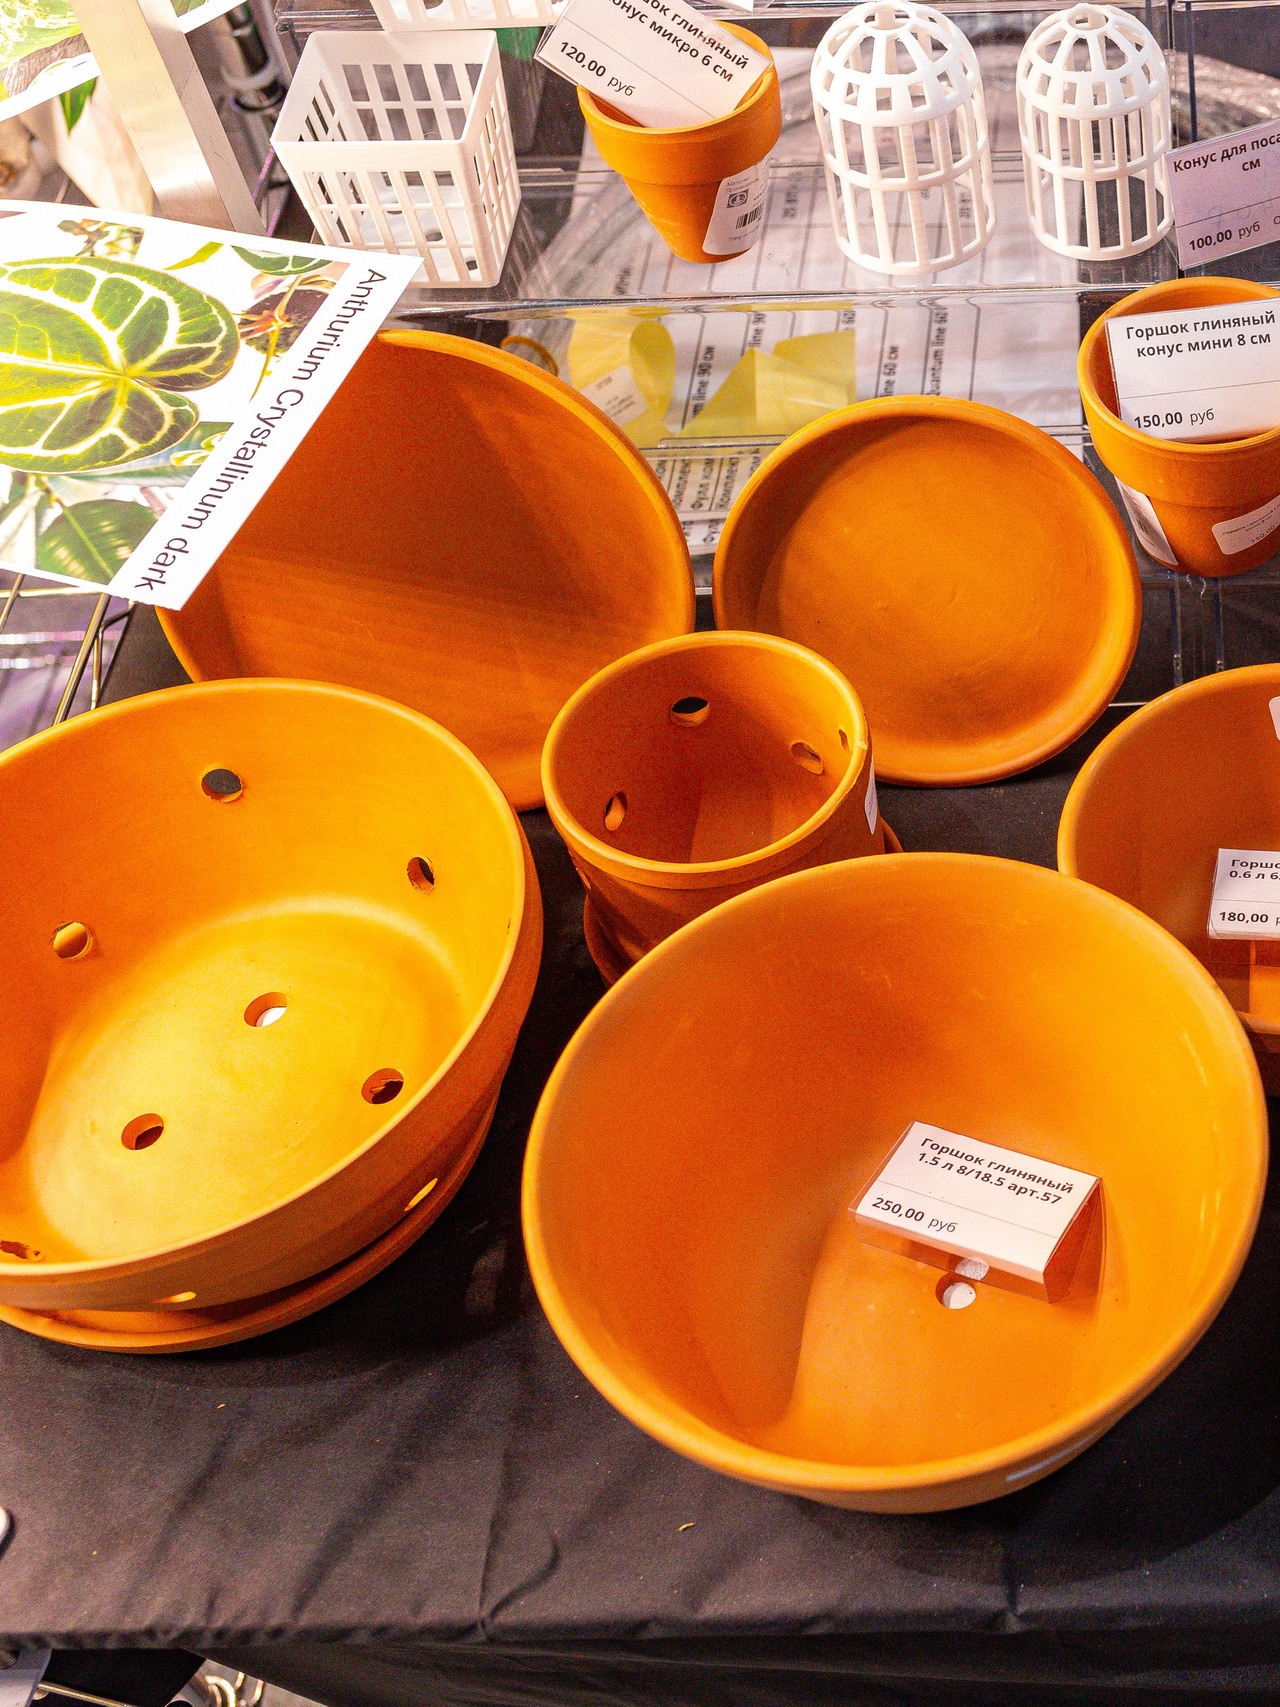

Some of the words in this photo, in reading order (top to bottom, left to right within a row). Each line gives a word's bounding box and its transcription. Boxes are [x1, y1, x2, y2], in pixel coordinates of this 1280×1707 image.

[609, 0, 648, 23] онус
[649, 21, 699, 58] микро
[701, 55, 713, 66] 6
[713, 64, 733, 82] см
[671, 13, 749, 69] глиняный
[560, 41, 606, 77] 120,00
[607, 75, 636, 96] руб
[1173, 152, 1217, 172] Конус
[1221, 143, 1247, 162] для
[1241, 159, 1261, 171] см
[1189, 229, 1232, 250] 100,00
[1238, 221, 1260, 239] руб
[292, 269, 387, 381] Anthurium
[1126, 322, 1189, 341] Горшок
[1193, 311, 1276, 333] глиняный
[1137, 341, 1184, 357] конус
[1188, 338, 1233, 352] мини
[1237, 333, 1246, 346] 8
[1250, 331, 1271, 344] см
[1134, 411, 1183, 428] 150,00
[1190, 408, 1215, 425] руб
[181, 388, 304, 530] Crystallinum
[134, 537, 189, 591] dark
[1229, 870, 1251, 879] 0.6
[1255, 872, 1265, 880] л
[1219, 911, 1269, 924] 180,00
[918, 1152, 940, 1166] 1.5
[941, 1161, 954, 1171] л
[956, 1164, 1004, 1187] 8/18.5
[1007, 1183, 1063, 1205] арт.57
[921, 1138, 984, 1166] Горшок
[987, 1160, 1074, 1194] глиняный
[871, 1197, 925, 1222] 250,00
[927, 1217, 958, 1233] руб
